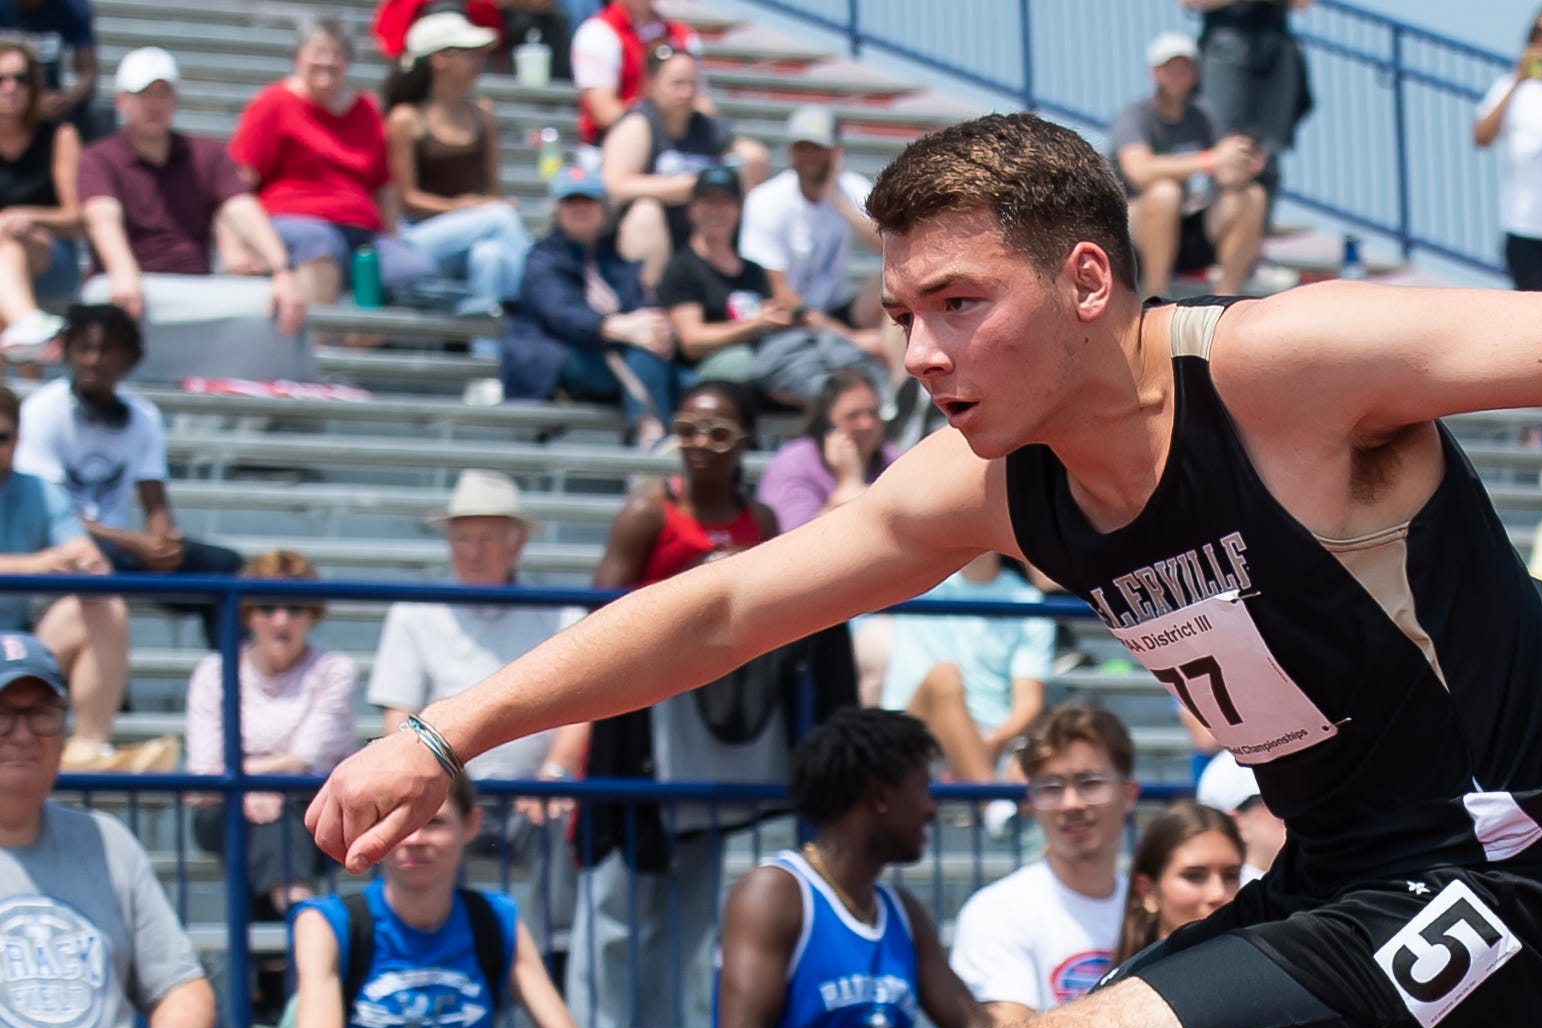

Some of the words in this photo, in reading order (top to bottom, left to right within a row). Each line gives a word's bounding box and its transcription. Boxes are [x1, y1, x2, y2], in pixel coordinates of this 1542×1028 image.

[1091, 531, 1252, 629] LERVILLE
[1140, 620, 1198, 650] District
[1194, 613, 1213, 633] III
[1151, 655, 1244, 728] 77
[1241, 728, 1309, 755] Championships
[1392, 897, 1503, 1003] 5
